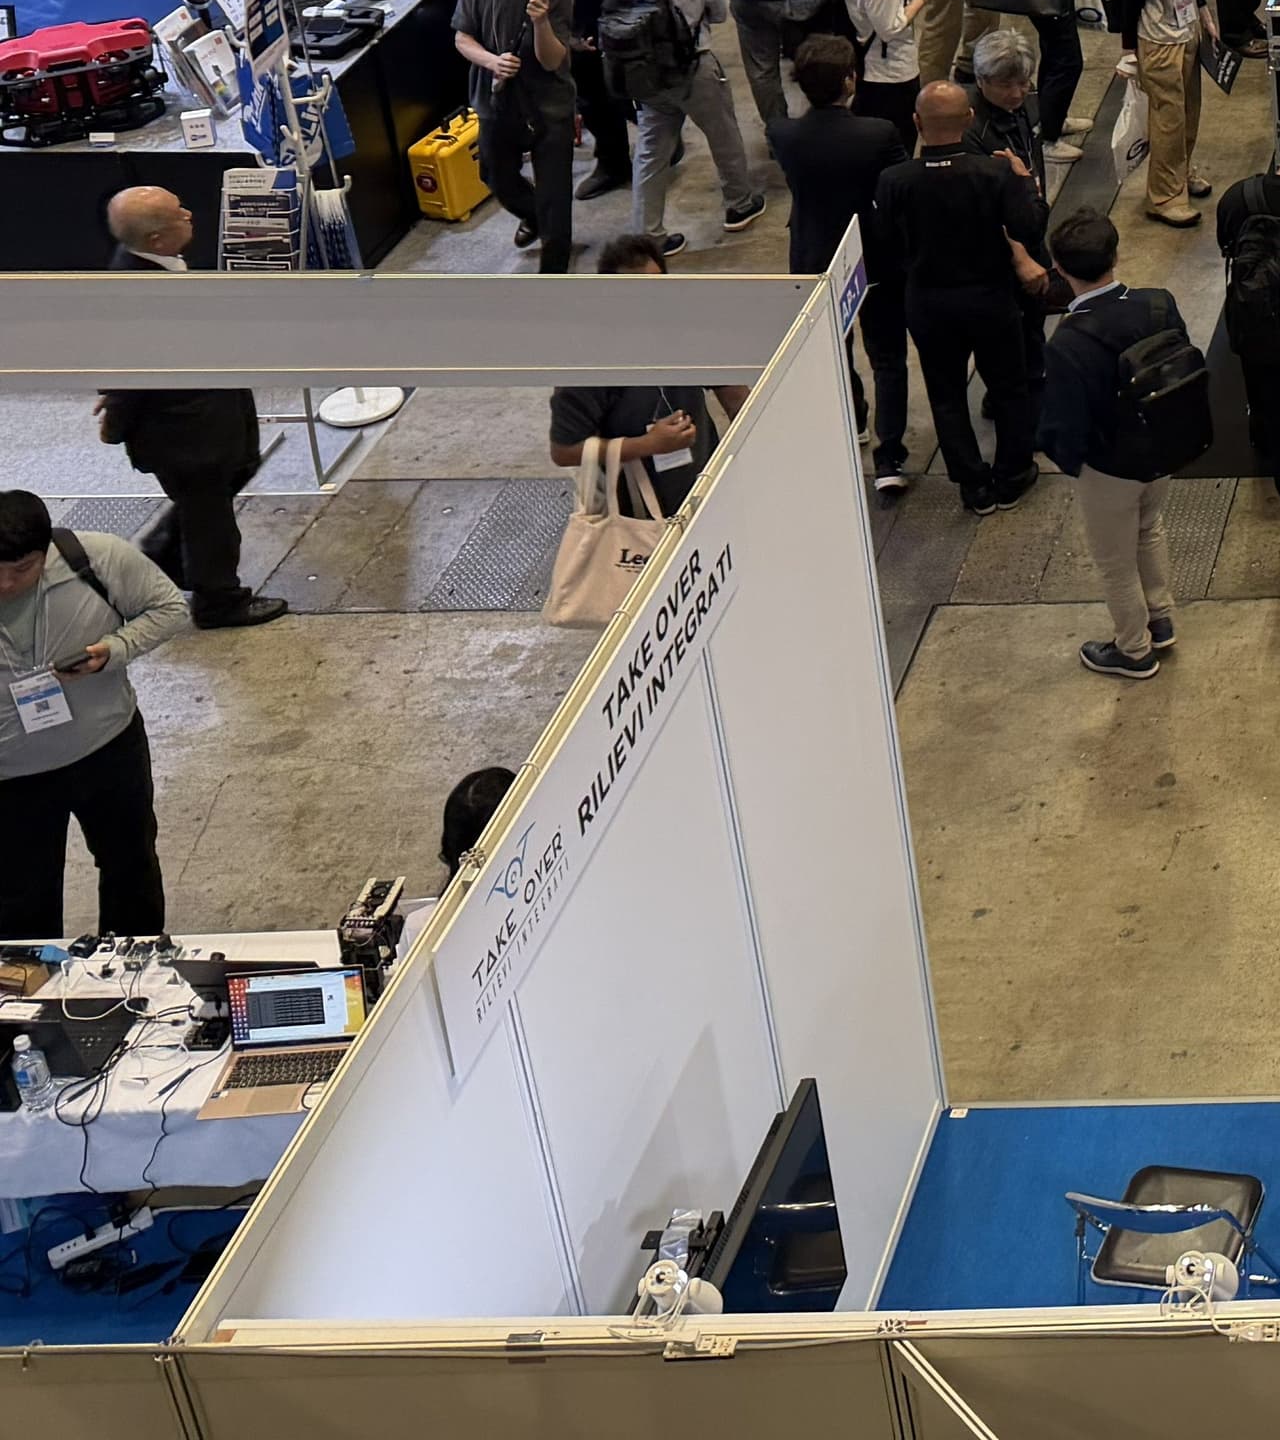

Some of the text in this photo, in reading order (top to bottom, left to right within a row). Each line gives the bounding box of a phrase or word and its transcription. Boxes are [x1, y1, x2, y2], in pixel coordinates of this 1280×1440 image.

[842, 279, 860, 323] AP-1
[575, 541, 733, 839] RILIEVI INTEGRATI
[601, 546, 704, 732] TAKE OVER
[472, 831, 564, 987] TAKE OVER
[475, 857, 569, 1024] RILIEVI INTEGRATI
